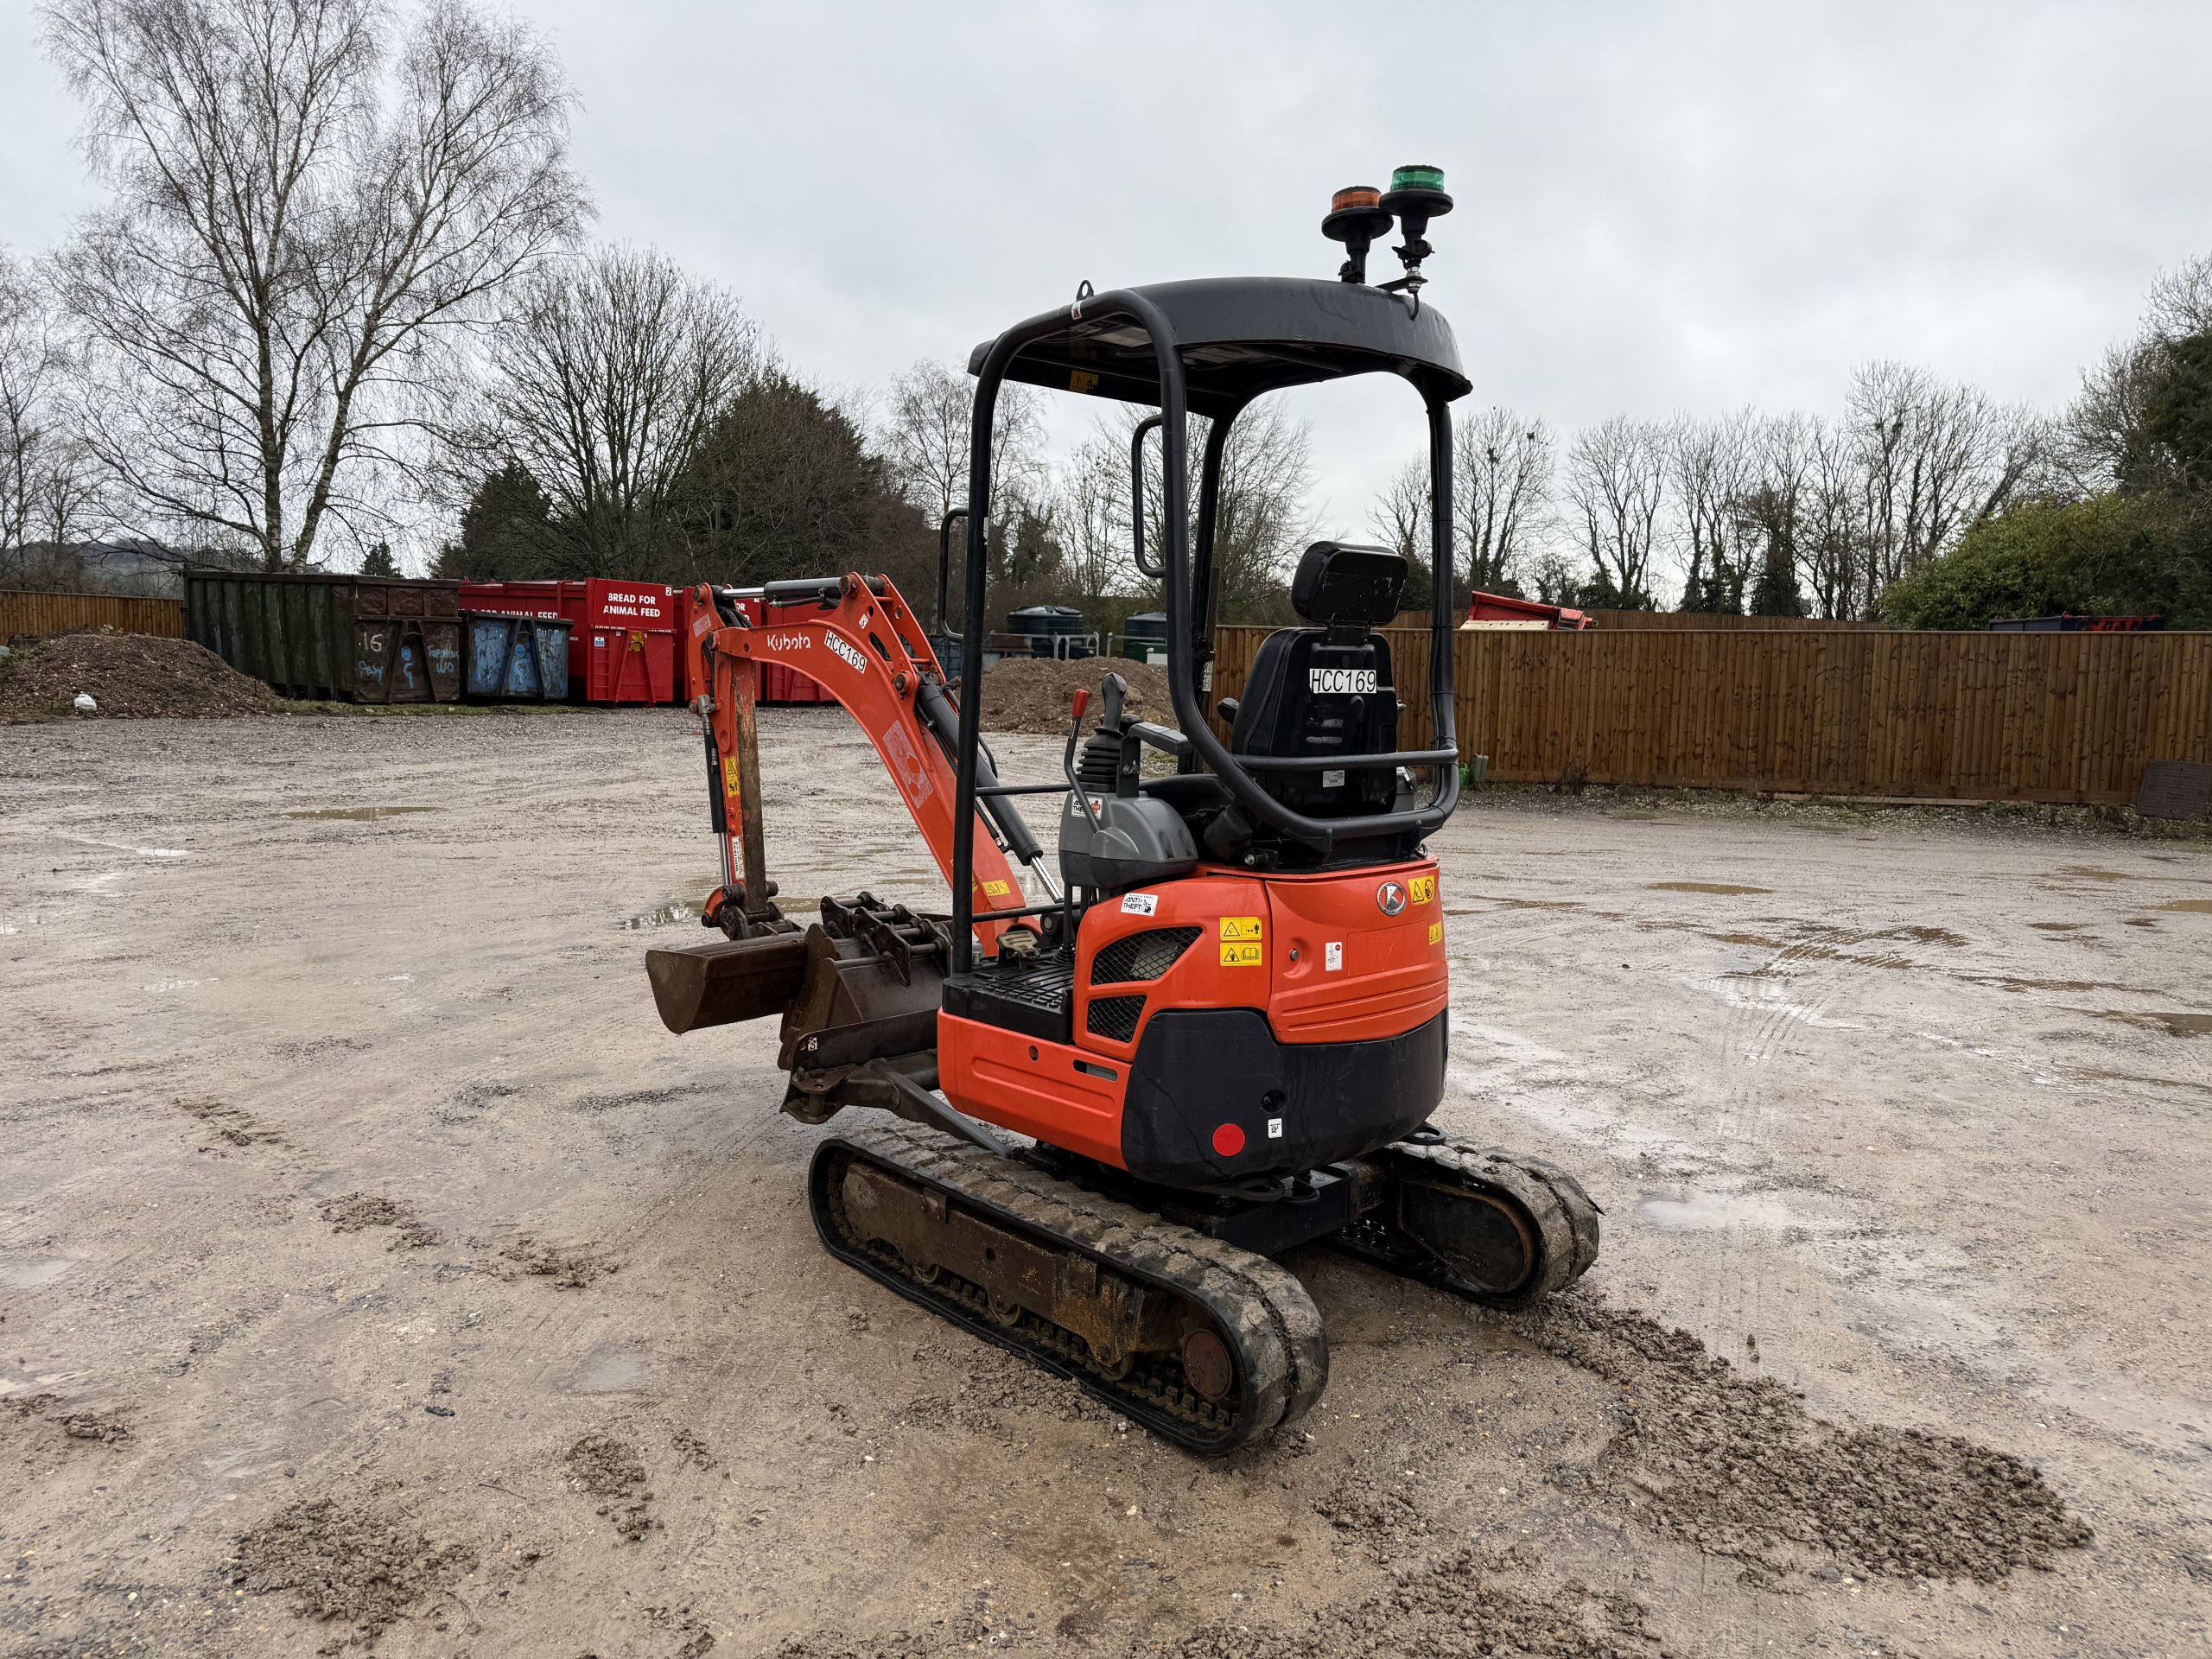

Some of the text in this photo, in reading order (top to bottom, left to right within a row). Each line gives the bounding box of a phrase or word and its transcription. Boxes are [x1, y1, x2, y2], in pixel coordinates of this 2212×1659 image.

[607, 593, 656, 605] BREAD FOR
[603, 605, 660, 618] ANIMAL FEED
[767, 632, 810, 651] Kubota
[825, 631, 866, 671] HCC169
[1312, 670, 1376, 692] HCC169
